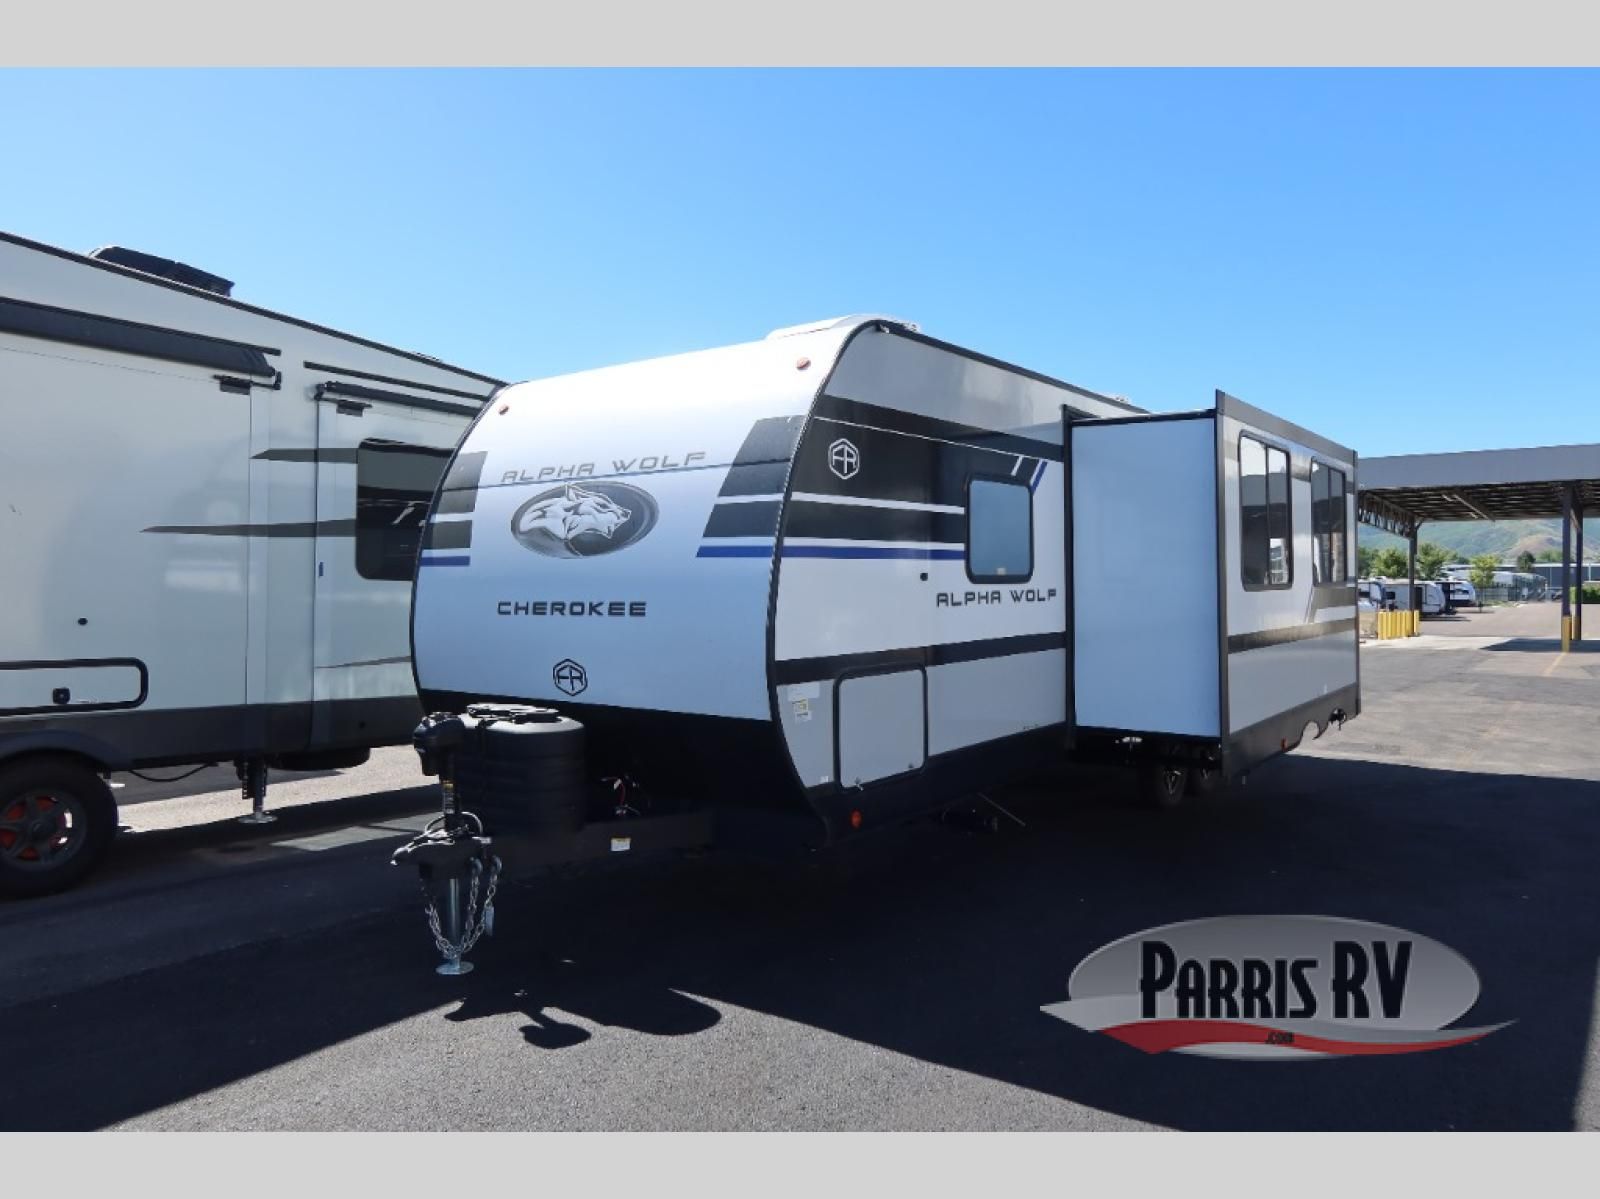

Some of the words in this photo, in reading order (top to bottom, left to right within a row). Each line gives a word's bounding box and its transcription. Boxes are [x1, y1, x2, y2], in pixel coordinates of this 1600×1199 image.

[501, 463, 596, 483] ALPHA
[611, 451, 706, 473] WOLF
[936, 590, 1001, 608] ALPHA
[1009, 588, 1057, 603] WOLF
[497, 601, 648, 617] CHEROKEE
